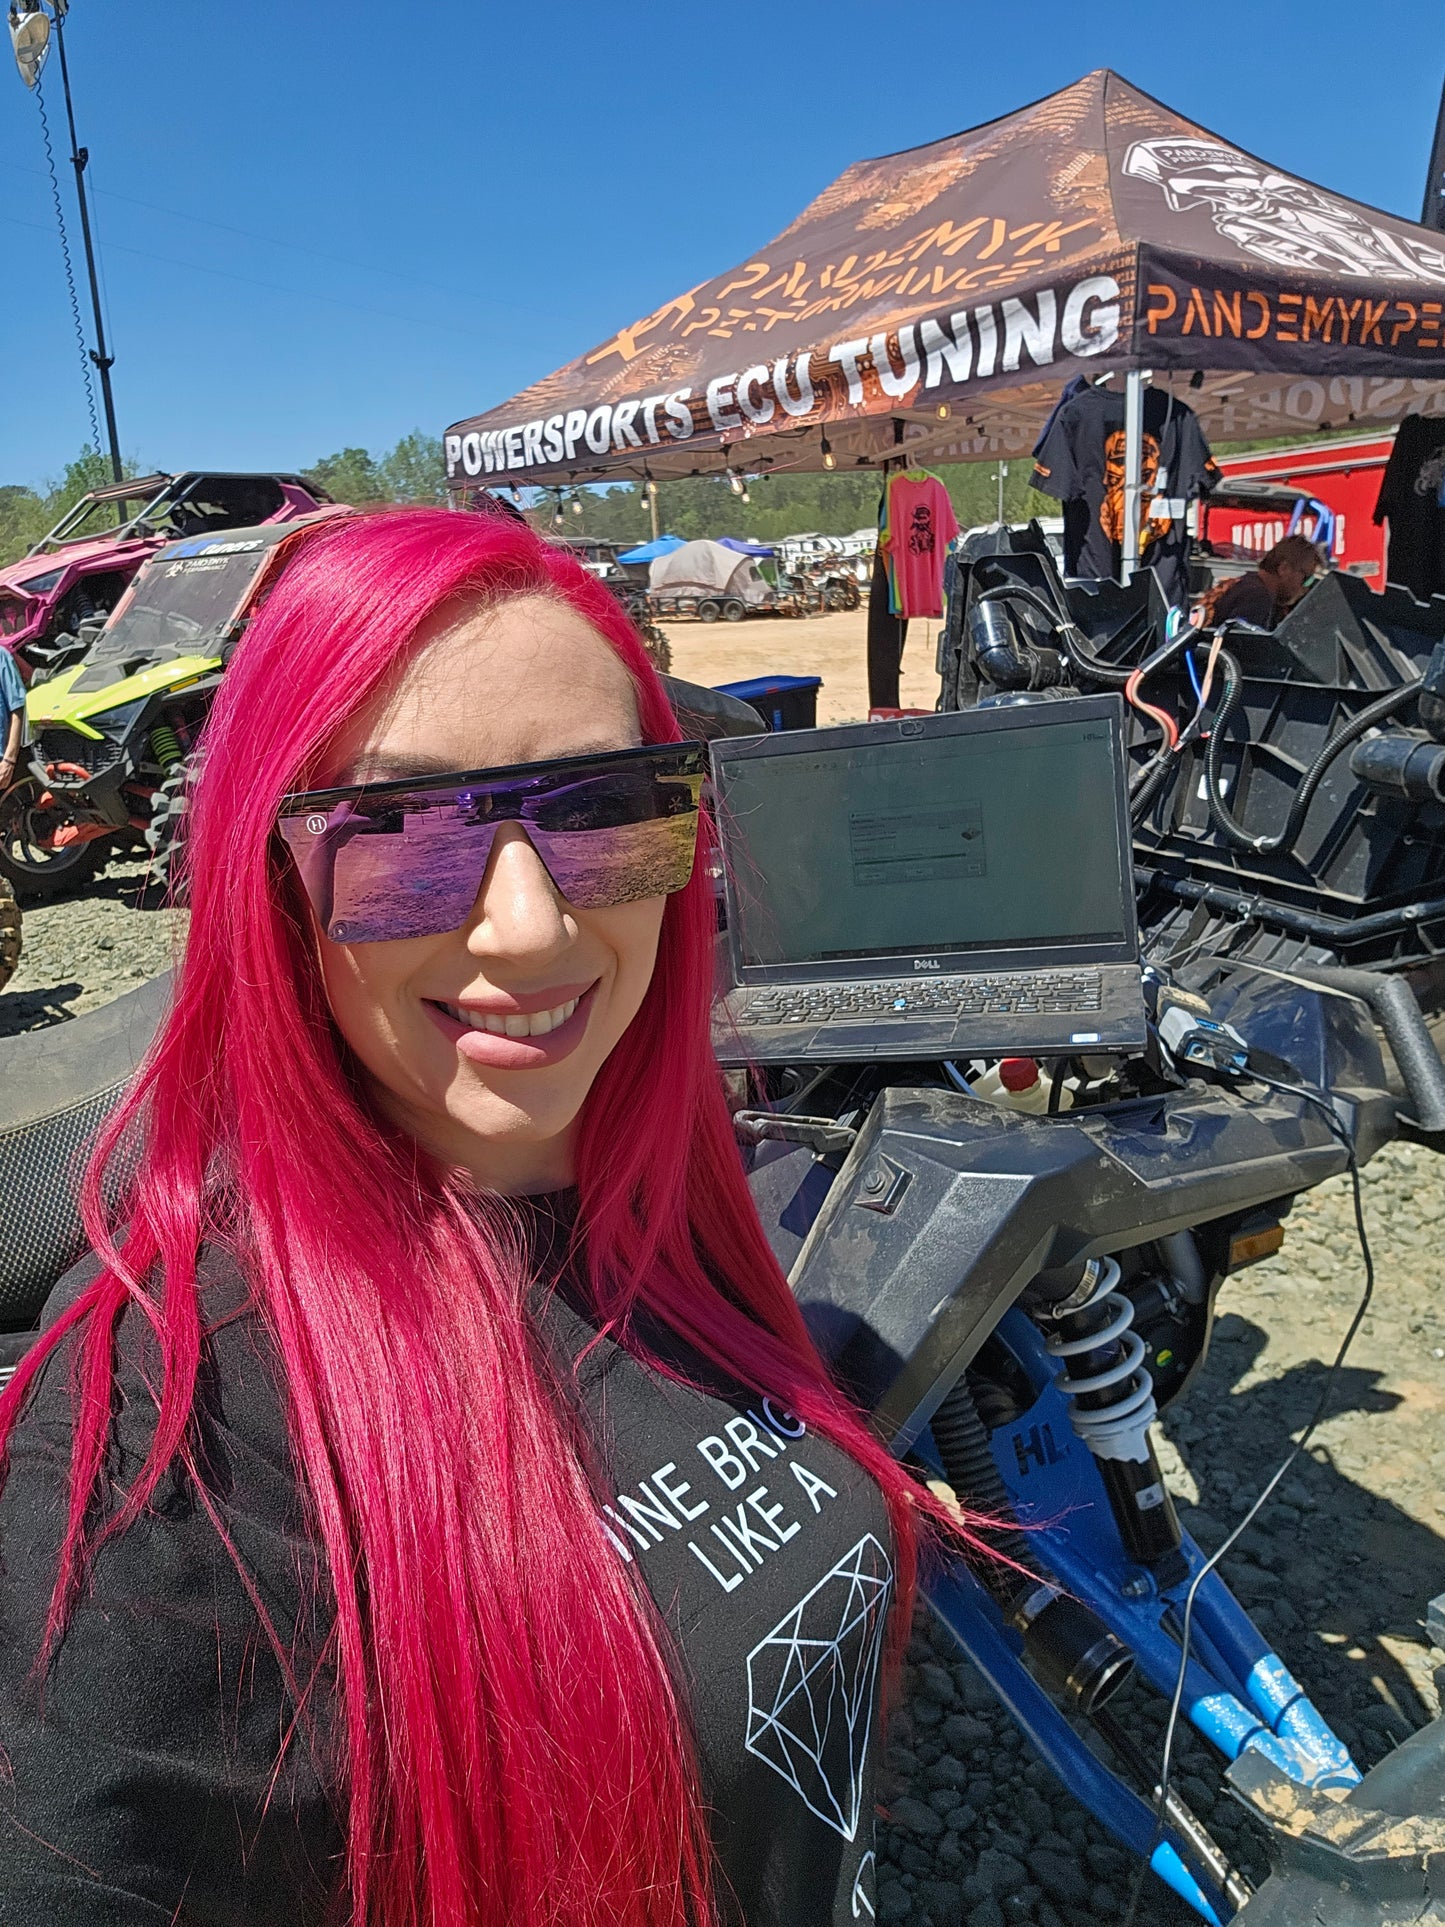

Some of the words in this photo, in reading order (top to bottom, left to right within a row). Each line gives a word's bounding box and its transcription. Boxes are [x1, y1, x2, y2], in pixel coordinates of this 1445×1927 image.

[1147, 284, 1445, 348] PANDEMYKPE
[445, 387, 694, 478] POWERSPORTS
[705, 352, 815, 431] ECU
[828, 275, 1120, 405] TUNING
[914, 959, 940, 970] DELL
[687, 1485, 802, 1595] LIKE
[789, 1461, 838, 1514] A
